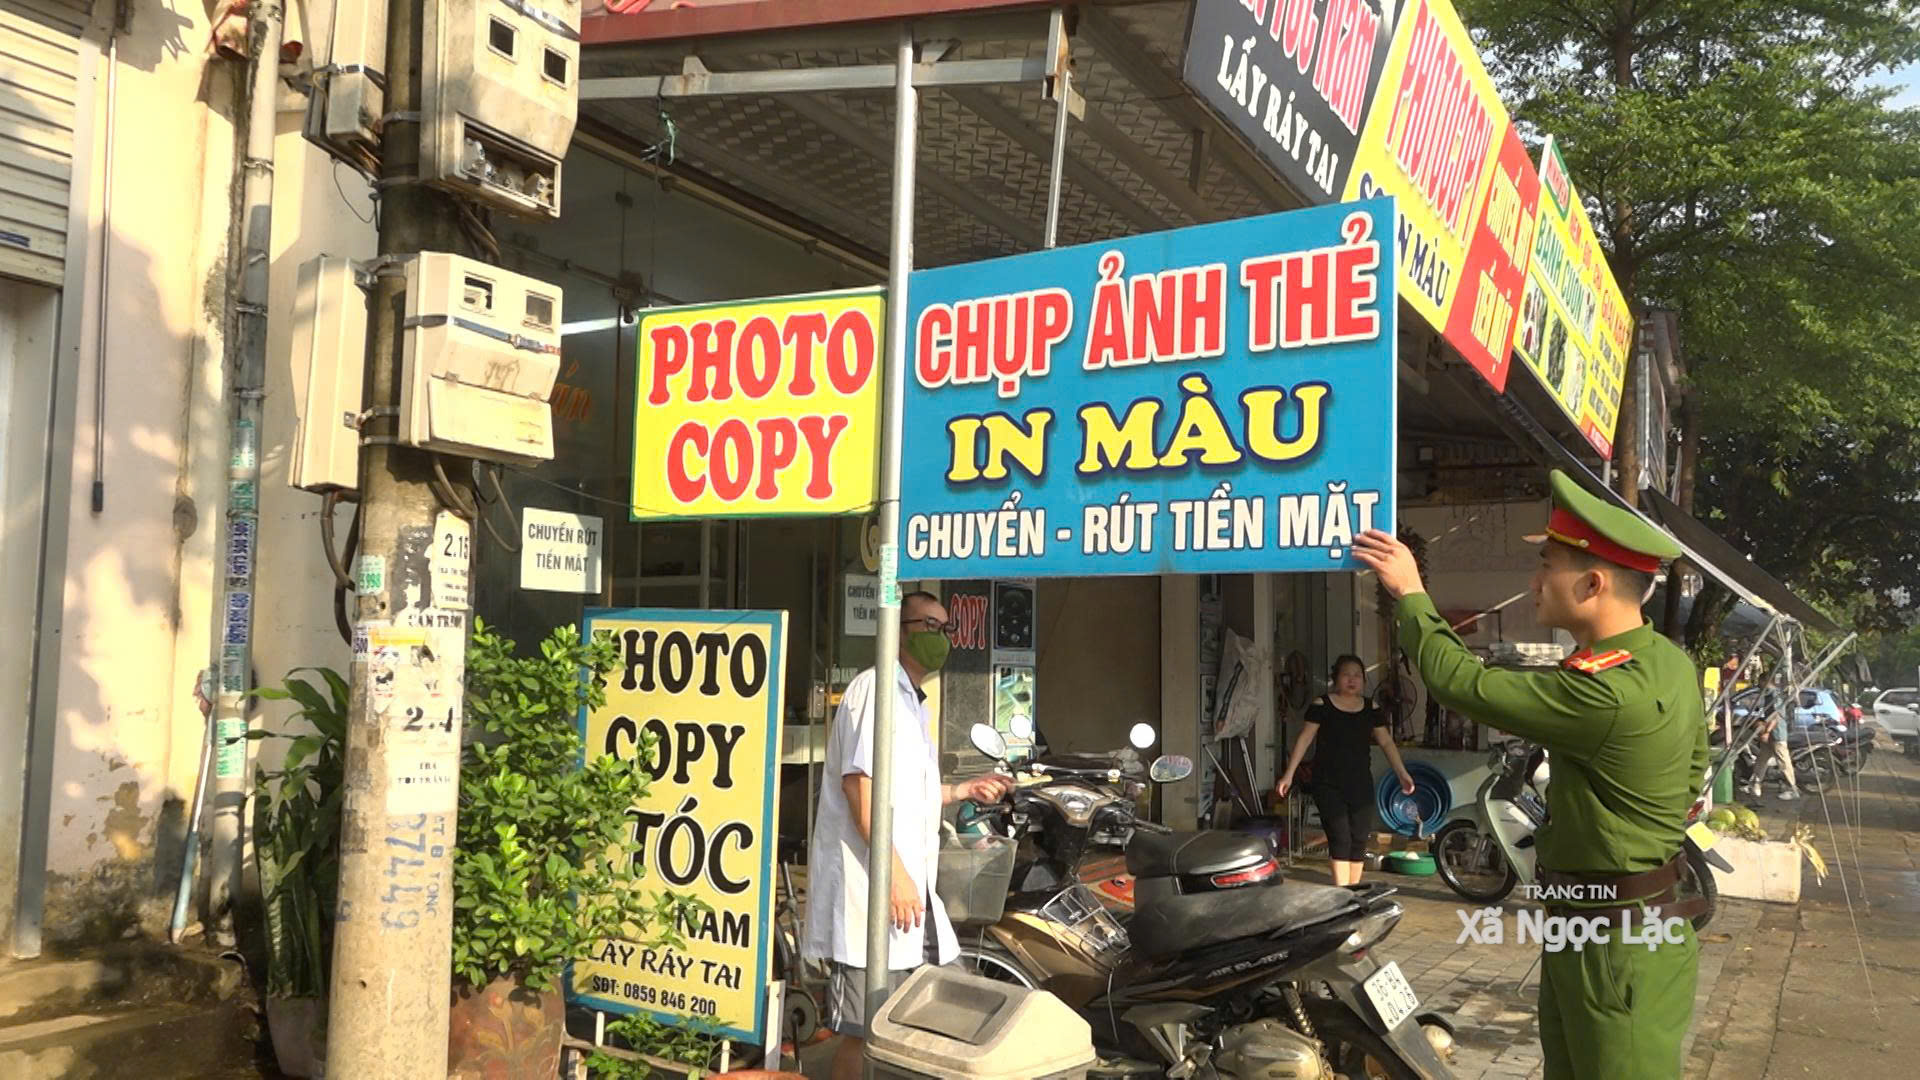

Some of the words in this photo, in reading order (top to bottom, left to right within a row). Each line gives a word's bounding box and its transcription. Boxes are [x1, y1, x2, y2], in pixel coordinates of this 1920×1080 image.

[1263, 84, 1309, 161] RÁY
[1306, 129, 1339, 195] TAI
[1385, 0, 1495, 248] PHOTOCOPY
[915, 288, 1073, 398] CHỤP
[1083, 250, 1227, 371] ẢNH
[1241, 211, 1380, 353] THẺ
[1409, 238, 1450, 308] MÀU
[648, 310, 876, 405] PHOTO
[666, 415, 849, 503] COPY
[946, 407, 1056, 485] IN
[1077, 373, 1331, 478] MÀU
[576, 527, 599, 546] RÚT
[907, 489, 1047, 561] CHUYỂN
[1083, 491, 1159, 555] RÚT
[1169, 480, 1265, 551] TIỀN
[1278, 480, 1381, 559] MẶT
[951, 593, 988, 650] COPY
[605, 716, 746, 789] COPY
[625, 796, 754, 895] TÓC
[676, 904, 751, 948] NAM
[592, 974, 620, 996] SĐT:
[624, 982, 657, 1004] 0859
[660, 989, 686, 1010] 846
[690, 995, 716, 1017] 200
[640, 947, 694, 980] RÁY
[700, 960, 742, 990] TAI
